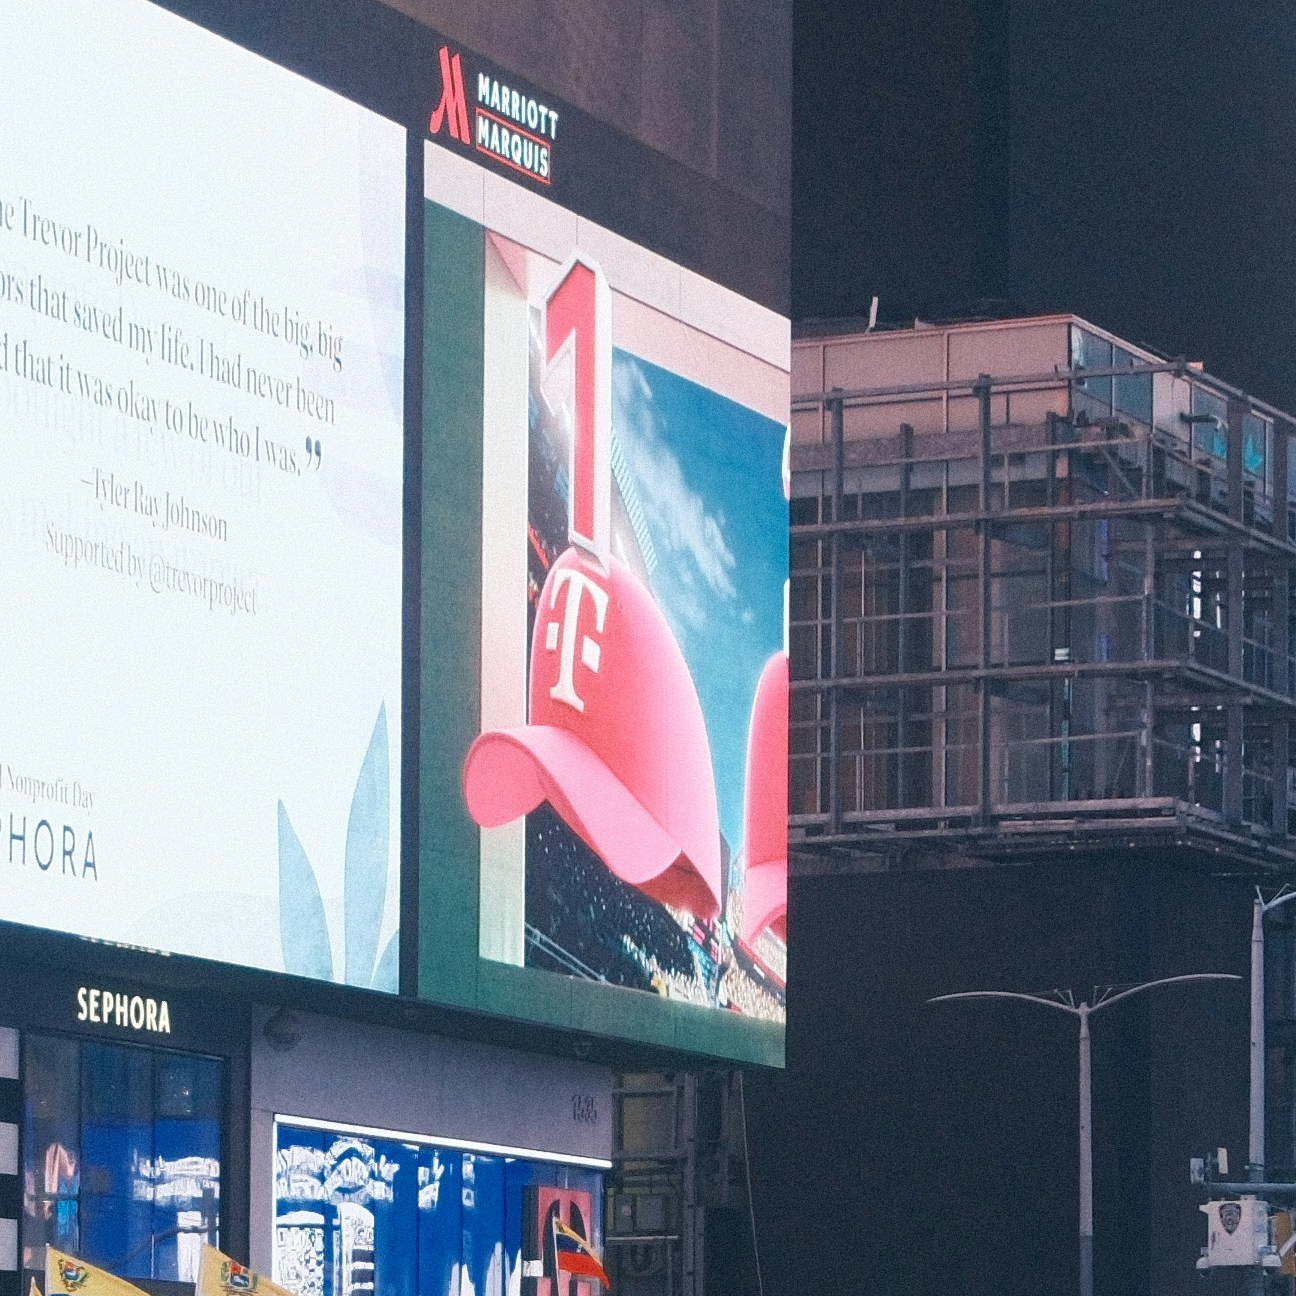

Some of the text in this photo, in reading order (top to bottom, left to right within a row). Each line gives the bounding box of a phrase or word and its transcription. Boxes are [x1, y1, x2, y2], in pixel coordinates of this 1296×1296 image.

[477, 71, 559, 140] MARRIOTT
[477, 114, 550, 179] MARQUIS
[19, 195, 82, 261] Trevor
[86, 224, 151, 286] Project
[156, 262, 190, 301] was
[195, 280, 228, 317] one
[232, 289, 252, 325] of
[253, 296, 280, 339] the
[318, 319, 343, 373] big
[30, 273, 69, 324] that
[74, 297, 123, 344] saved
[128, 319, 154, 365] my
[209, 342, 242, 390] had
[246, 367, 293, 411] never
[296, 376, 336, 426] been
[14, 337, 53, 389] that
[59, 354, 72, 395] it
[77, 370, 112, 409] was
[117, 380, 160, 435] okay
[165, 399, 183, 434] to
[188, 402, 209, 444] be
[212, 415, 251, 459] who
[134, 479, 160, 528] Ray
[163, 490, 229, 542] Johnson
[45, 521, 258, 617] Supported by @trevorproject
[6, 764, 69, 806] Nonprofit
[72, 781, 94, 816] Day
[77, 986, 171, 1035] SEPHORA
